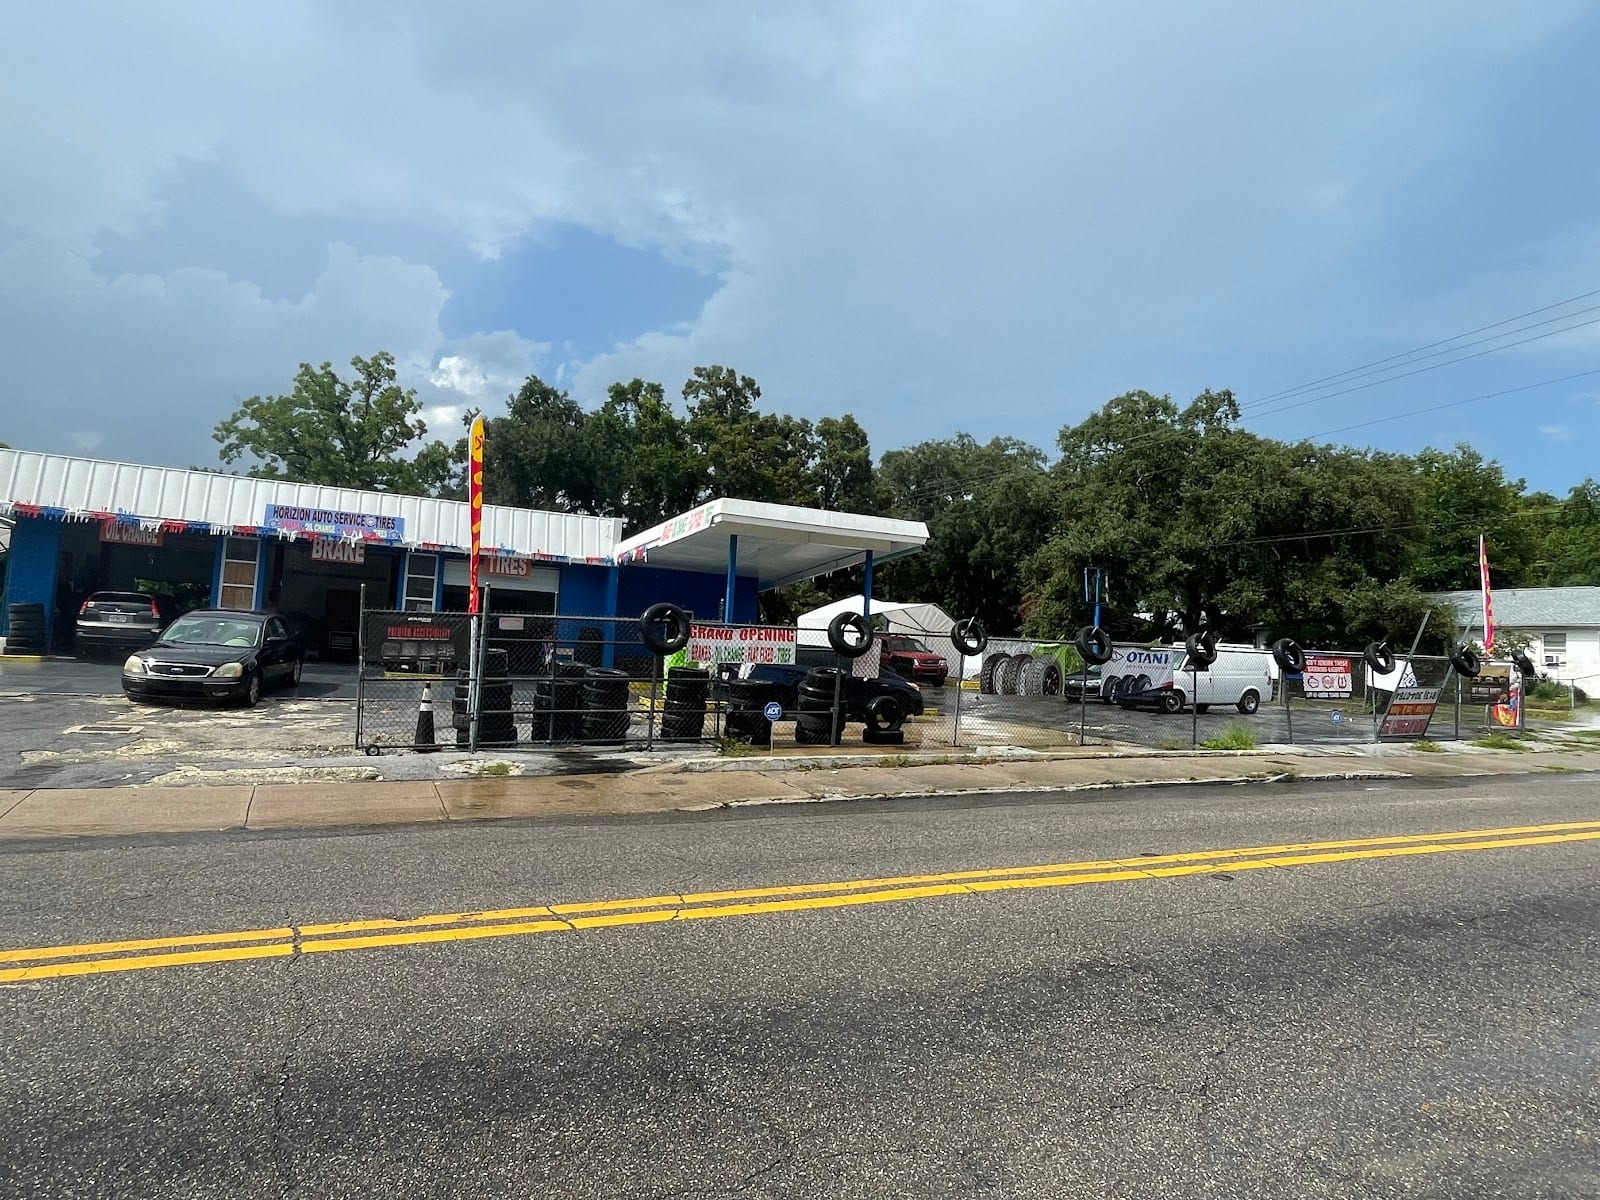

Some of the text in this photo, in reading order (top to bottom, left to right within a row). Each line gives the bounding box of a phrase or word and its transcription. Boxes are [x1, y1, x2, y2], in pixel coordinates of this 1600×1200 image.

[273, 506, 396, 530] HORIZION AUTO SERVICE TIRES
[311, 539, 365, 563] BRAKE
[488, 555, 527, 576] TIRES
[690, 626, 794, 642] GRAND OPENING
[1127, 652, 1169, 664] OTANI
